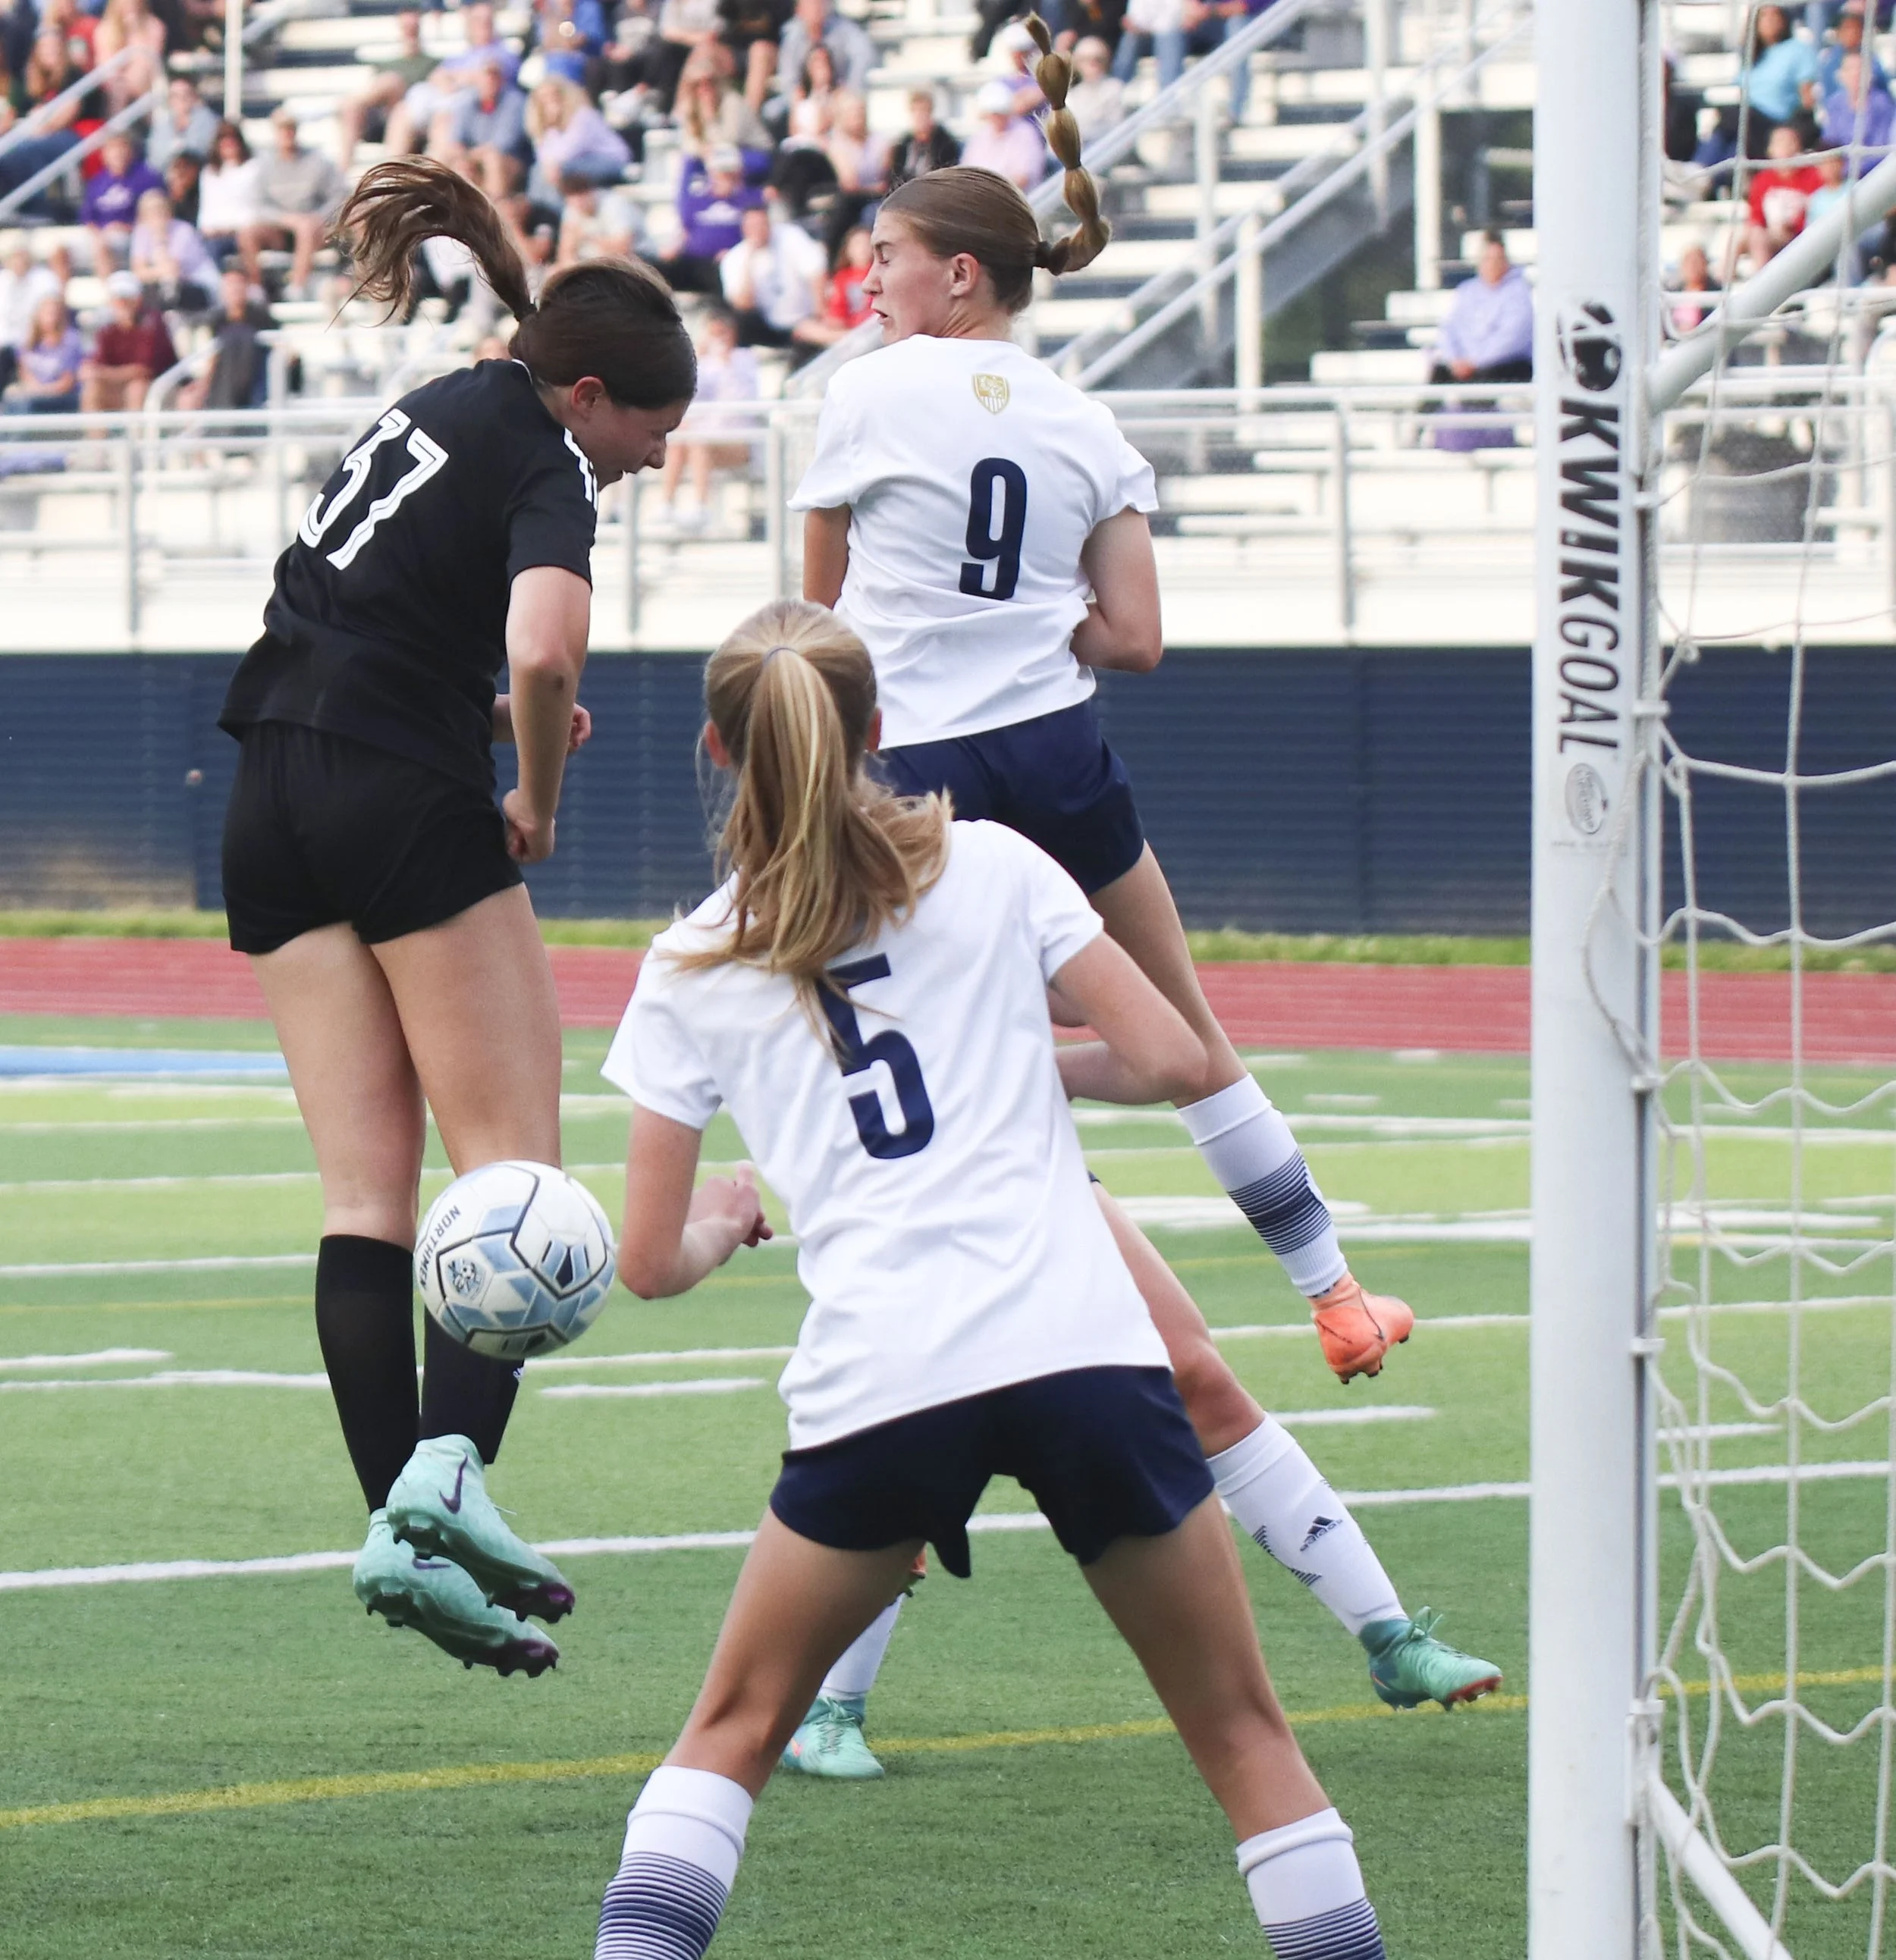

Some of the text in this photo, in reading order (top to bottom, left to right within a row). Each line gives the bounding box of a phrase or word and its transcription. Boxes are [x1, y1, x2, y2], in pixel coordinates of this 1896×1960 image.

[298, 407, 450, 571] 37
[959, 457, 1028, 601] 9
[813, 952, 935, 1159] 5
